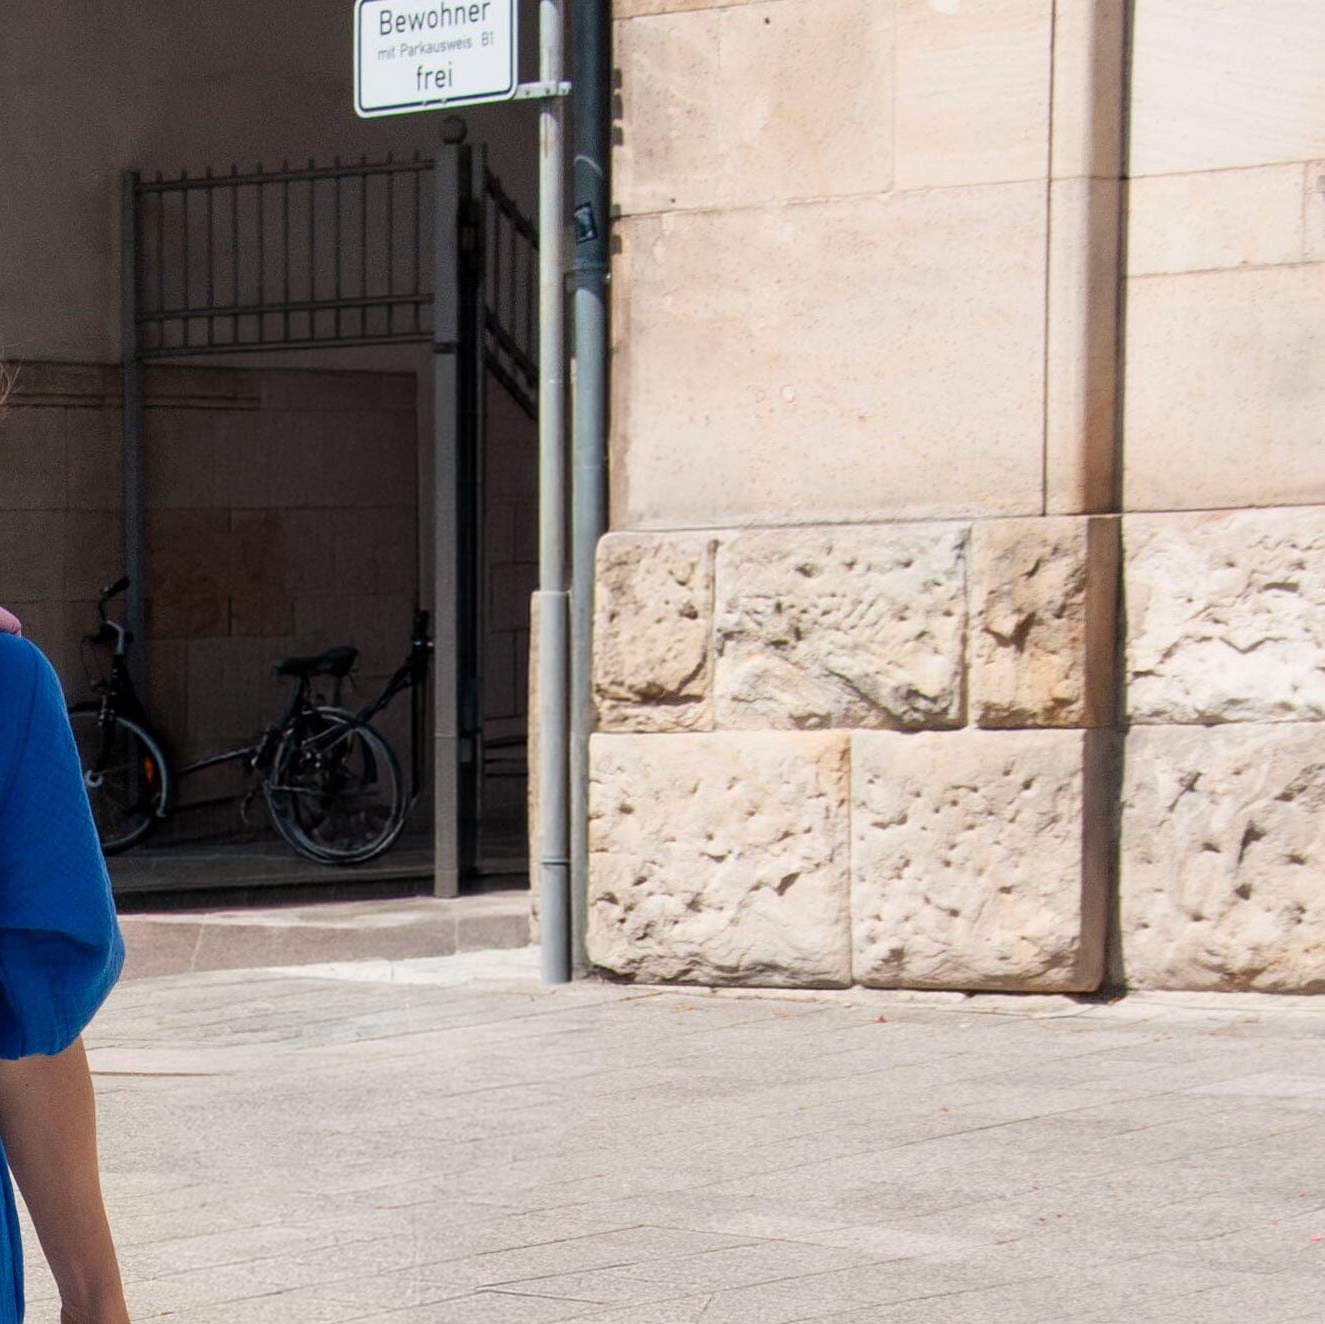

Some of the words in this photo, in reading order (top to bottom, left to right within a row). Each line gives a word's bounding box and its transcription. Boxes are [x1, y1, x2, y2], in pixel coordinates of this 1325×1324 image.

[379, 0, 491, 36] Bewohner
[378, 46, 396, 61] mit
[399, 37, 473, 58] Parkausweis
[416, 61, 454, 92] frei
